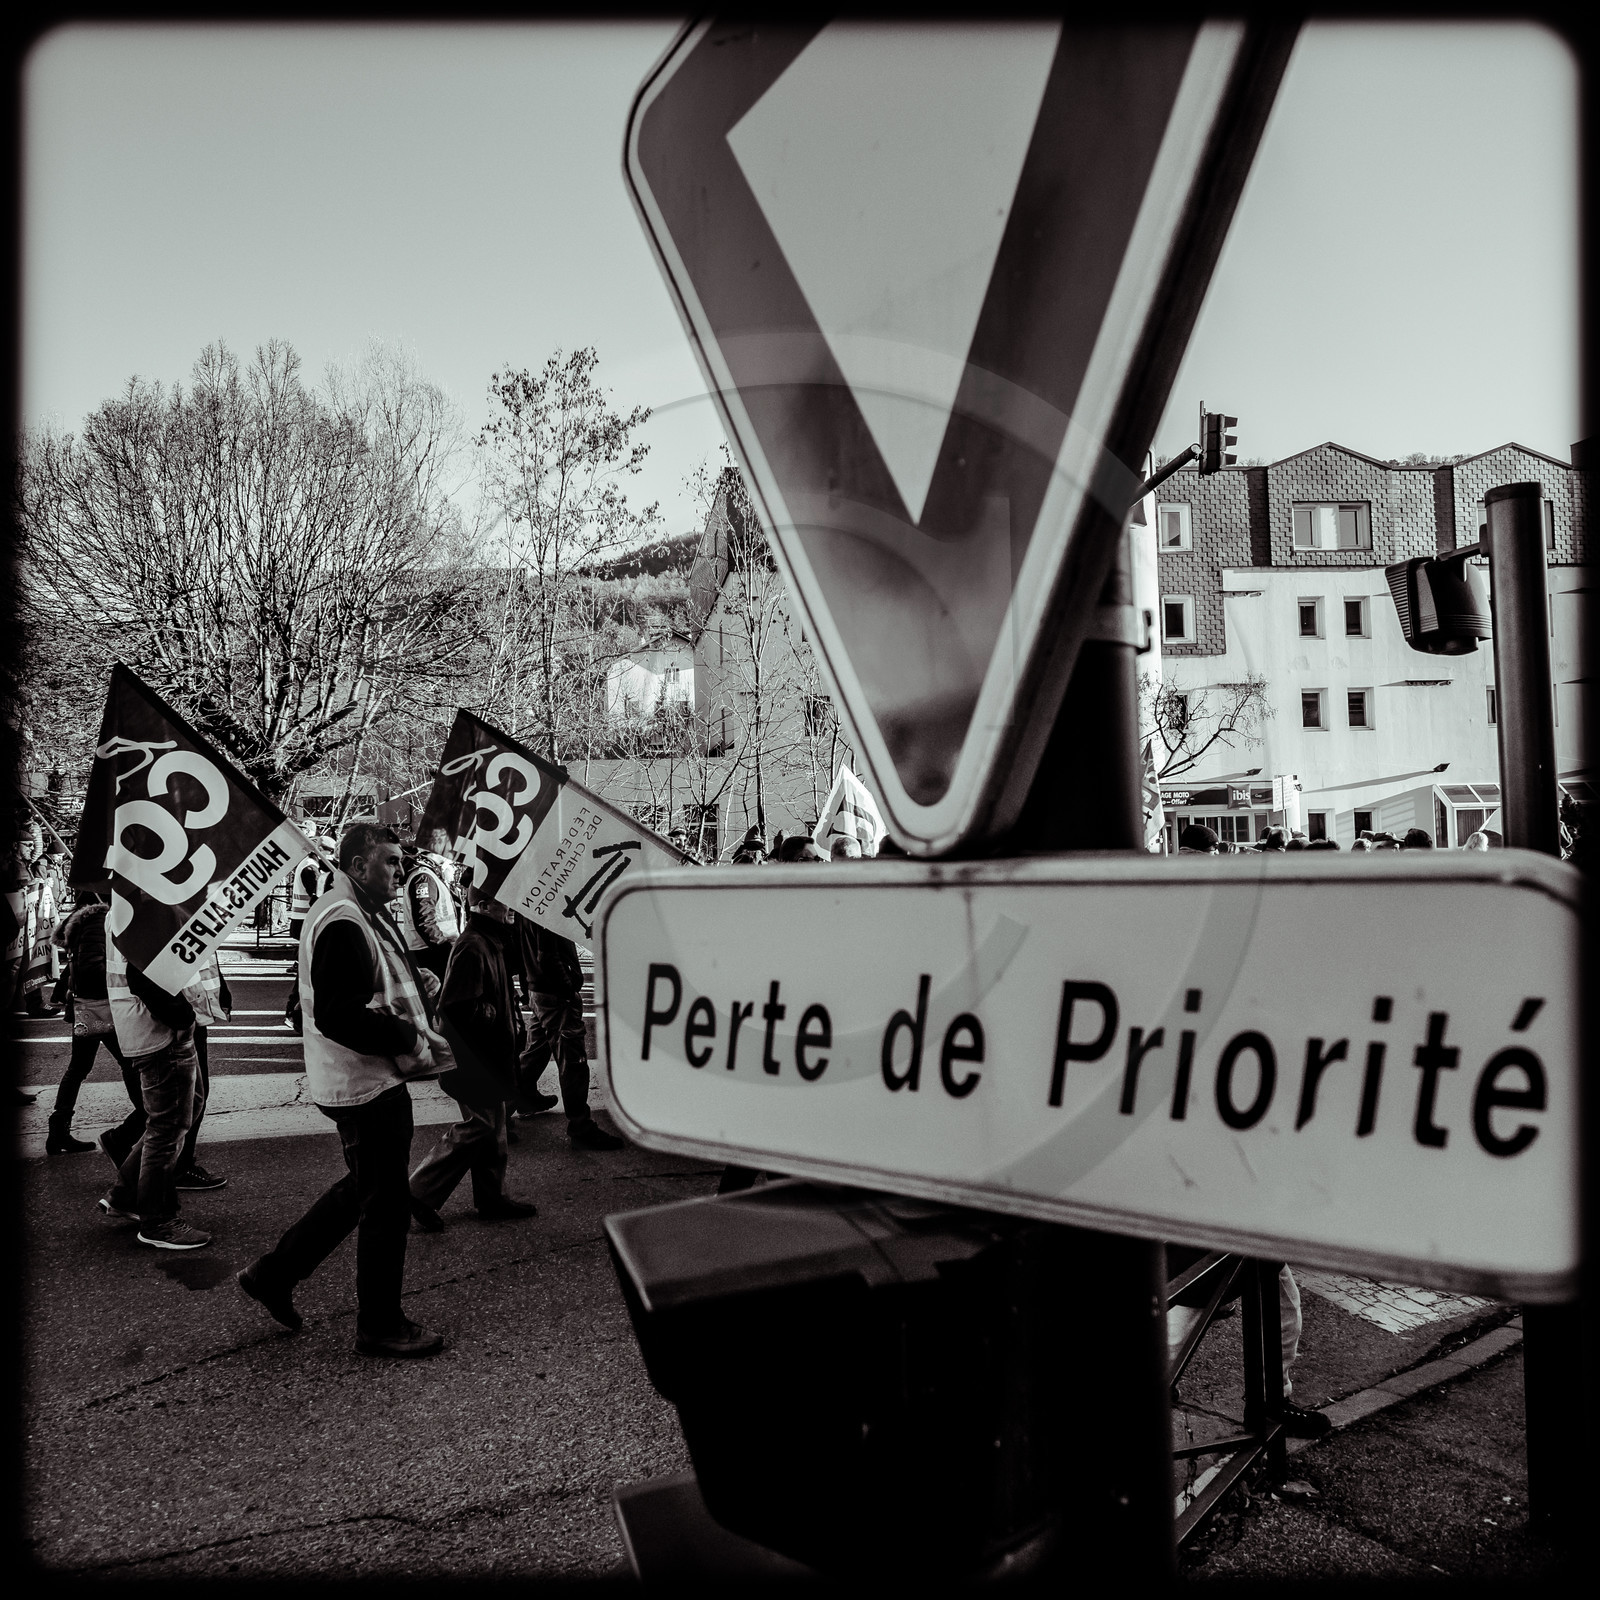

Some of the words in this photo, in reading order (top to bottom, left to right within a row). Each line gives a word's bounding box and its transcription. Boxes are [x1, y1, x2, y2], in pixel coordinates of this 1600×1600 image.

[1232, 789, 1251, 801] ibis
[640, 962, 834, 1081] Perte
[879, 973, 986, 1098] de
[1047, 978, 1549, 1159] Priorité
